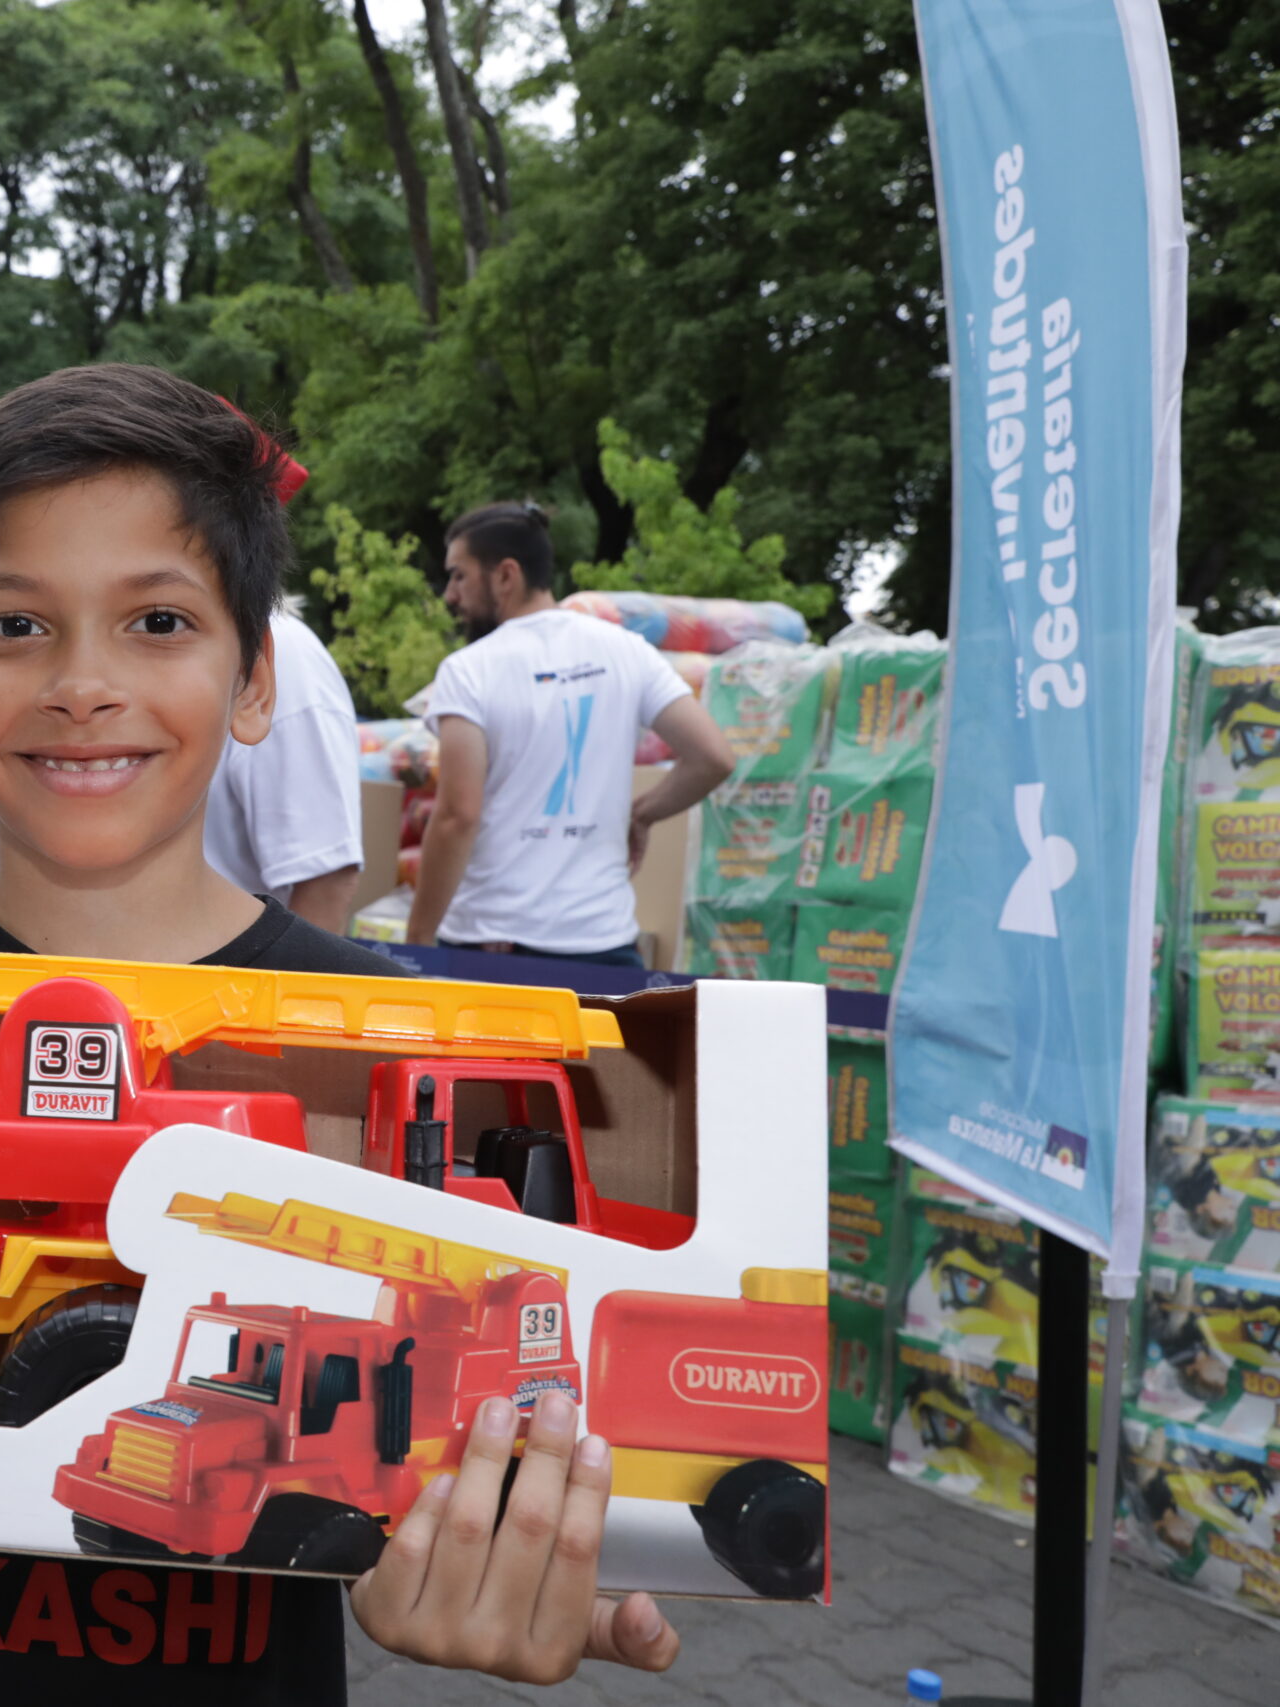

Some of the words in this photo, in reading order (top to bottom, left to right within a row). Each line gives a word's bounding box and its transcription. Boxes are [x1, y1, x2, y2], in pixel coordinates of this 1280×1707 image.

[1214, 815, 1280, 837] CAMI
[1213, 838, 1280, 862] VOLC
[1216, 965, 1280, 986] CAMI
[36, 1030, 110, 1080] 39
[33, 1091, 111, 1114] DURAVIT
[526, 1308, 557, 1335] 39
[685, 1362, 806, 1399] DURAVIT
[511, 1388, 578, 1404] BOMOS
